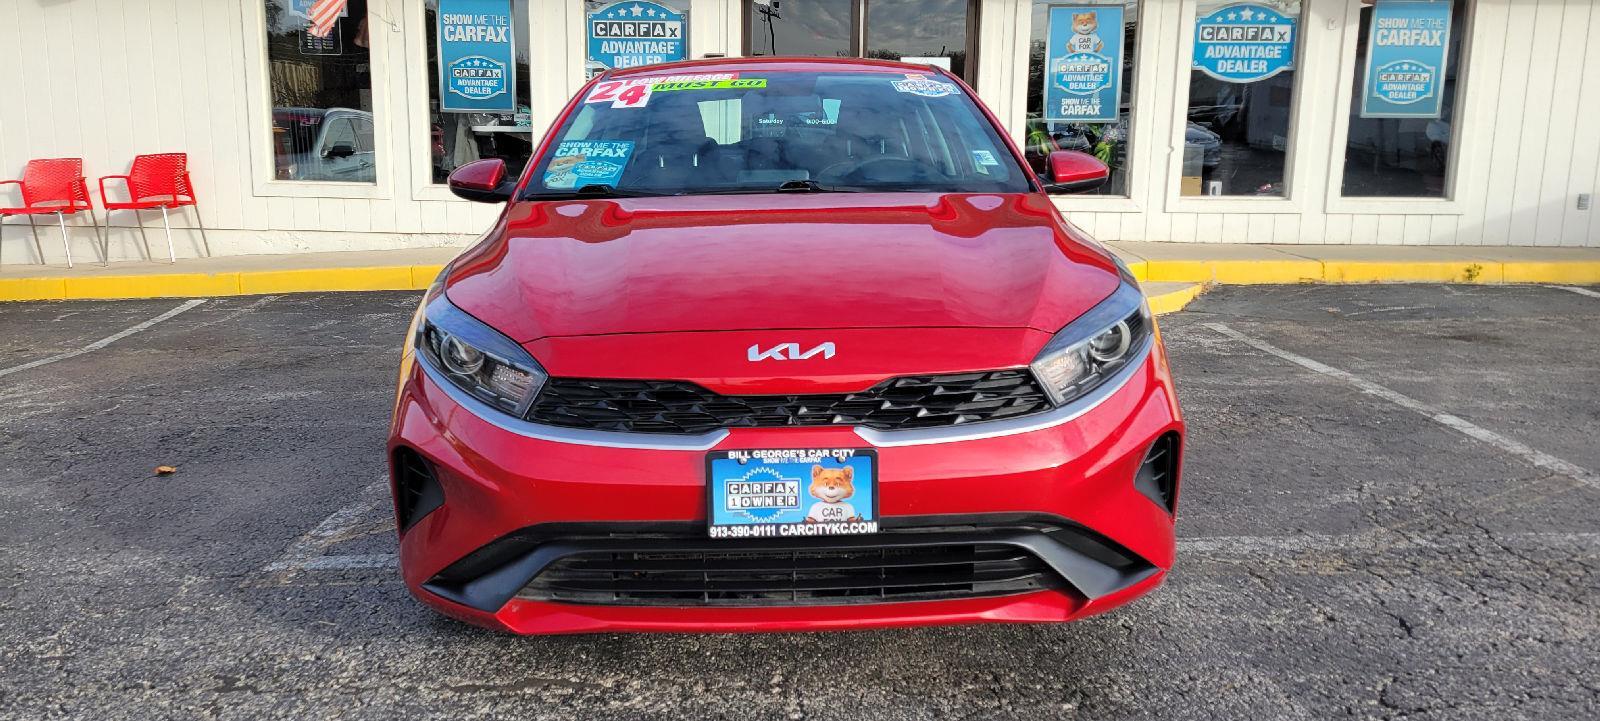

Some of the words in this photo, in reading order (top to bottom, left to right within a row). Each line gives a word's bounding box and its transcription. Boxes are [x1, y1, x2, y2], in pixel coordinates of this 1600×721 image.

[443, 14, 472, 25] SHOW
[475, 15, 488, 25] ME
[490, 15, 507, 26] THE
[1378, 18, 1408, 29] SHOW
[1411, 19, 1424, 29] ME
[1426, 19, 1444, 29] THE
[444, 25, 508, 42] CARFAX
[594, 23, 678, 38] CARFAX
[1202, 27, 1287, 41] CARFAX
[1377, 29, 1441, 47] CARFAX
[601, 41, 676, 54] ADVANTAGE
[1205, 45, 1282, 58] ADVANTAGE
[1217, 60, 1268, 73] DEALER
[454, 69, 500, 77] CARFAX
[654, 80, 721, 91] MUST
[730, 80, 761, 88] GO
[1062, 98, 1079, 106] SHOW
[1061, 105, 1101, 116] CARFAX
[554, 148, 629, 157] CARFAX
[747, 342, 836, 361] KIA
[728, 451, 750, 459] BILL
[753, 450, 806, 458] GEORGE'S
[808, 449, 830, 458] CAR
[831, 449, 855, 458] CITY
[729, 483, 797, 495] CARFAX
[821, 508, 843, 517] CAR
[709, 524, 776, 537] 913-390-0111
[779, 522, 878, 536] CARCITYKC.COM
